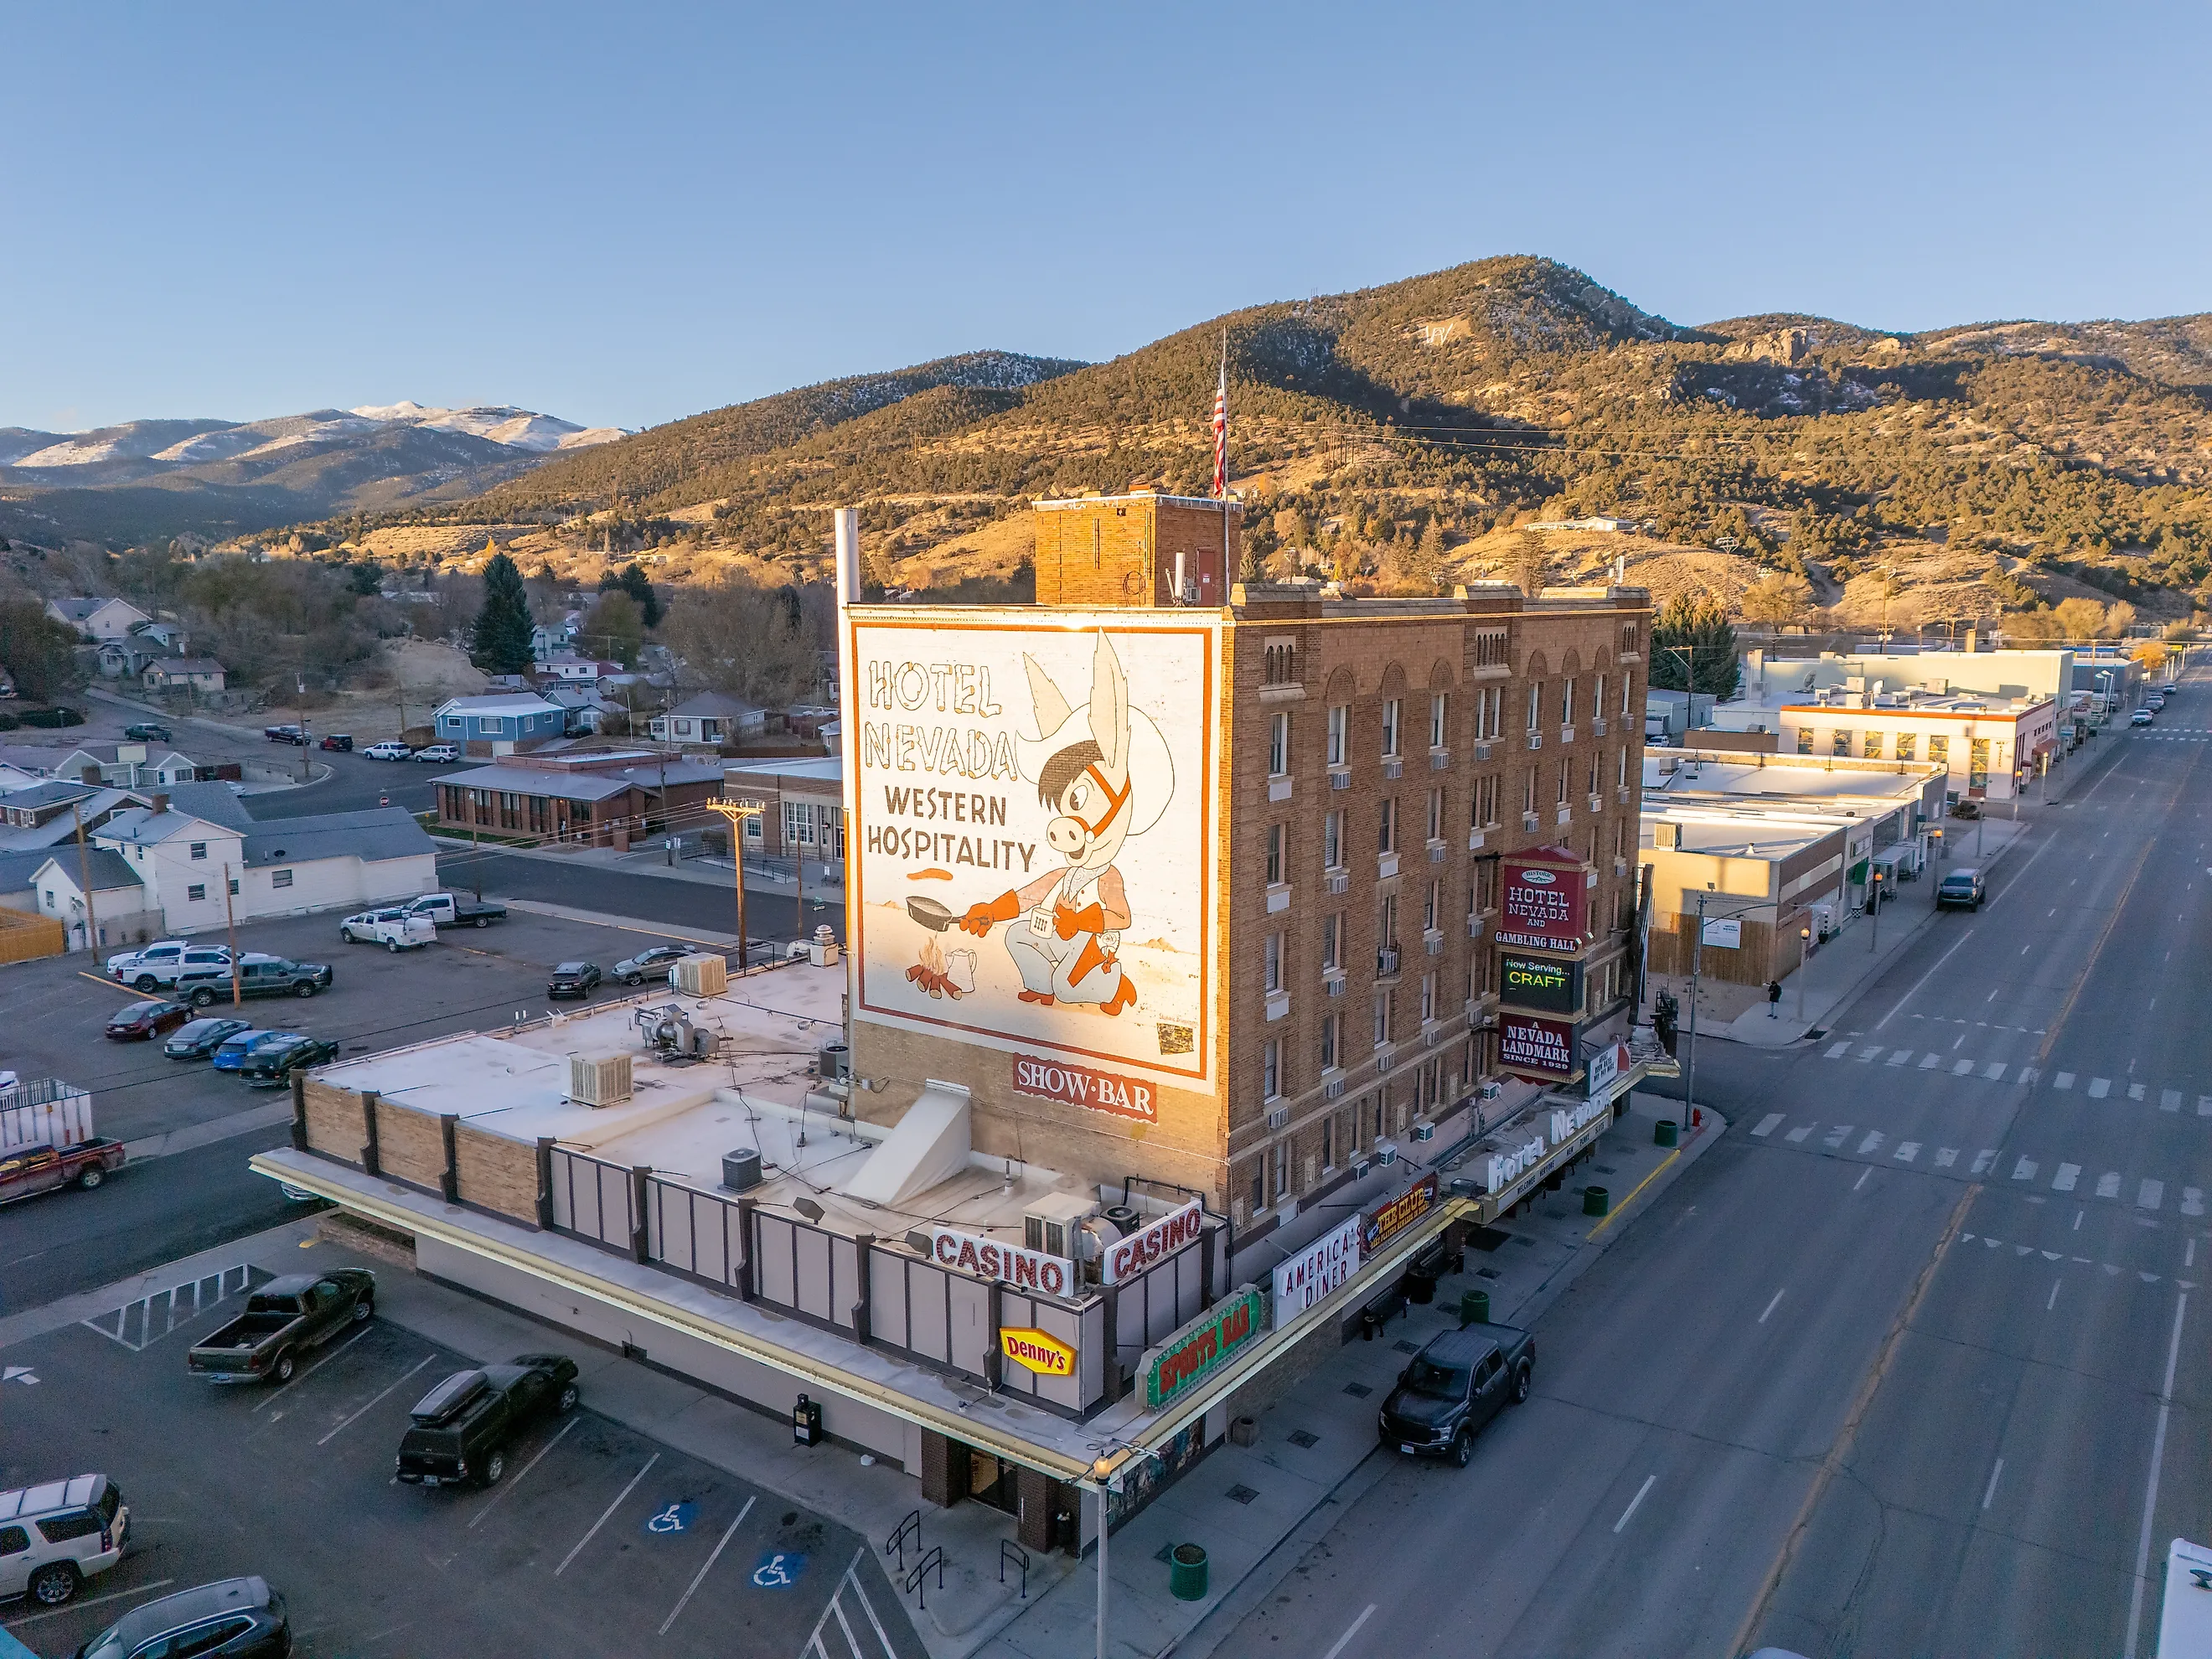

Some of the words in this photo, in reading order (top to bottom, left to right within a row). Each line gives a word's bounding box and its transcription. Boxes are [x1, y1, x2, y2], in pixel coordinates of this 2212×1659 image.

[869, 660, 1003, 718] HOTEL
[865, 721, 1019, 782] NEVADA
[885, 784, 1006, 827] WESTERN
[867, 825, 1036, 872] HOSPITALITY
[1526, 871, 1553, 879] HISTORIC
[1508, 903, 1569, 921] NEVADA
[1509, 886, 1569, 907] HOTEL
[1495, 931, 1548, 948] GAMBLING
[1549, 938, 1576, 951] HALL
[1527, 918, 1546, 928] AND
[1506, 958, 1527, 969] Now
[1528, 962, 1570, 976] Serving...
[1509, 971, 1566, 988] CRAFT
[1502, 1039, 1569, 1062] LANDMARK
[1507, 1026, 1564, 1047] NEVADA
[1503, 1053, 1538, 1065] SINCE
[1542, 1060, 1569, 1070] 1929
[1488, 1135, 1548, 1194] HOTEL
[1551, 1088, 1612, 1145] NEVADA
[1377, 1206, 1397, 1234] THE
[1398, 1187, 1425, 1219] CLUB
[1114, 1207, 1202, 1279] CASINO
[1285, 1223, 1362, 1297] AMERICA'S
[935, 1233, 1063, 1295] CASINO
[1305, 1259, 1348, 1310] DINER
[1005, 1336, 1066, 1372] Denny's
[1160, 1324, 1217, 1395] SPORTS
[1220, 1303, 1250, 1350] BAR
